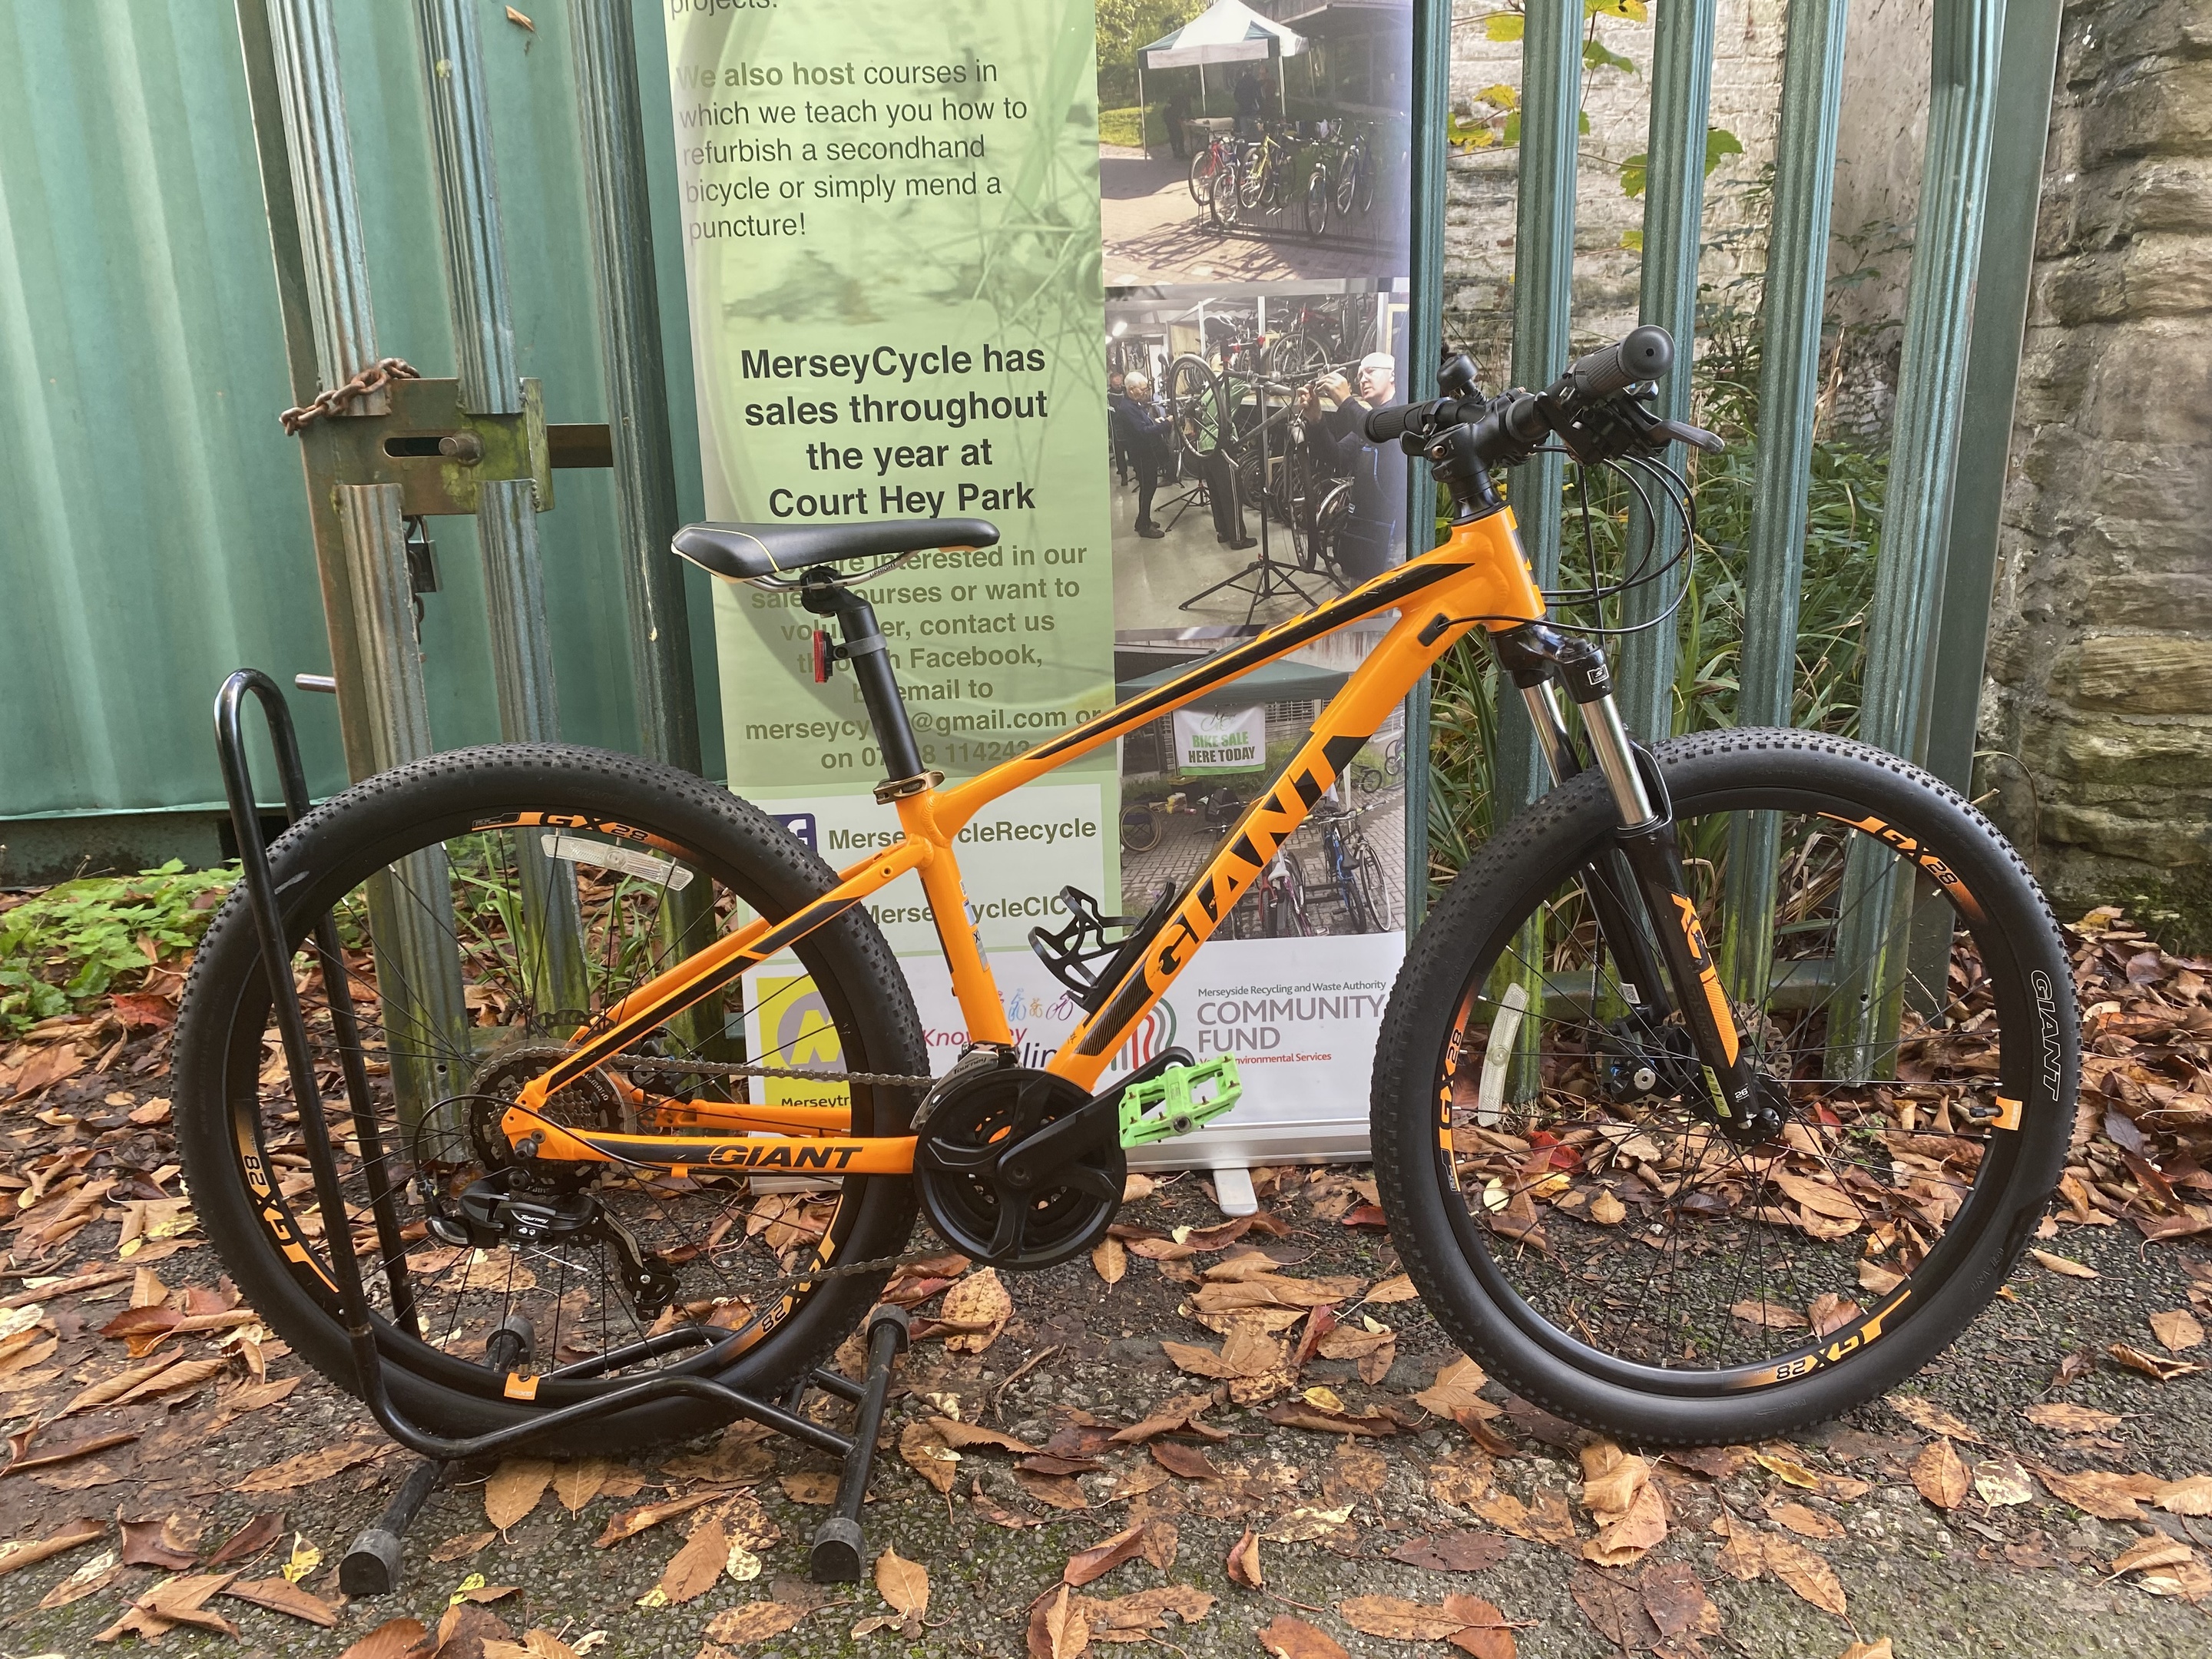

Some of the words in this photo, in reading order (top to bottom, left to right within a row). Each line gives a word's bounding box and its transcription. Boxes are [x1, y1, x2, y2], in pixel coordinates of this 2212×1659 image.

[675, 65, 716, 90] We
[724, 62, 783, 87] also
[793, 61, 855, 85] host
[863, 61, 967, 85] courses
[975, 58, 998, 82] in
[680, 101, 750, 128] which
[759, 104, 796, 124] we
[805, 99, 878, 124] teach
[886, 103, 932, 128] you
[942, 98, 995, 121] how
[1003, 97, 1028, 120] to
[683, 138, 792, 167] refurbish
[802, 143, 818, 161] a
[826, 134, 985, 161] secondhand
[686, 177, 770, 207] bicycle
[779, 179, 804, 199] or
[813, 174, 896, 203] simply
[906, 172, 978, 197] mend
[986, 175, 1002, 195] a
[690, 212, 806, 245] puncture!
[741, 345, 972, 384] MerseyCycle
[983, 343, 1045, 374] has
[745, 396, 839, 426] sales
[849, 390, 1048, 428] throughout
[806, 442, 863, 471] the
[873, 444, 949, 477] year
[961, 439, 992, 467] at
[769, 488, 868, 518] Court
[879, 485, 945, 518] Hey
[958, 482, 1035, 512] Park
[1012, 545, 1036, 567] in
[1044, 545, 1088, 565] our
[751, 588, 803, 609] sale
[853, 582, 942, 605] ourses
[951, 583, 976, 602] or
[985, 579, 1047, 601] want
[1055, 578, 1080, 598] to
[780, 620, 910, 641] voluer,
[919, 612, 1015, 636] contact
[1025, 611, 1055, 631] us
[909, 644, 1042, 671] Facebook,
[899, 679, 960, 701] email
[968, 679, 994, 698] to
[746, 709, 1067, 742] merseycy@gmail.com
[1192, 734, 1219, 748] BIKE
[1221, 731, 1250, 747] SALE
[821, 751, 853, 768] on
[945, 740, 1030, 763] 114243
[1188, 750, 1217, 763] HERE
[1218, 746, 1256, 763] TODAY
[829, 817, 1097, 850] MersecleRecycle
[1144, 735, 1340, 988] GIANT
[866, 894, 1068, 924] MerseycleCIC
[1198, 984, 1249, 998] Merseyside
[1251, 982, 1293, 997] Recycling
[1294, 982, 1311, 992] and
[1313, 982, 1341, 992] Waste
[1343, 980, 1386, 991] Authority
[1197, 994, 1386, 1026] COMMUNITY
[1199, 1026, 1280, 1053] FUND
[2031, 969, 2061, 1102] GIANT
[953, 1057, 987, 1075] Tourney
[1235, 1055, 1294, 1065] nvironmental
[1296, 1052, 1332, 1061] Services
[782, 1095, 851, 1107] Merseytr
[709, 1144, 863, 1168] GIANT
[520, 1214, 549, 1224] Tourney
